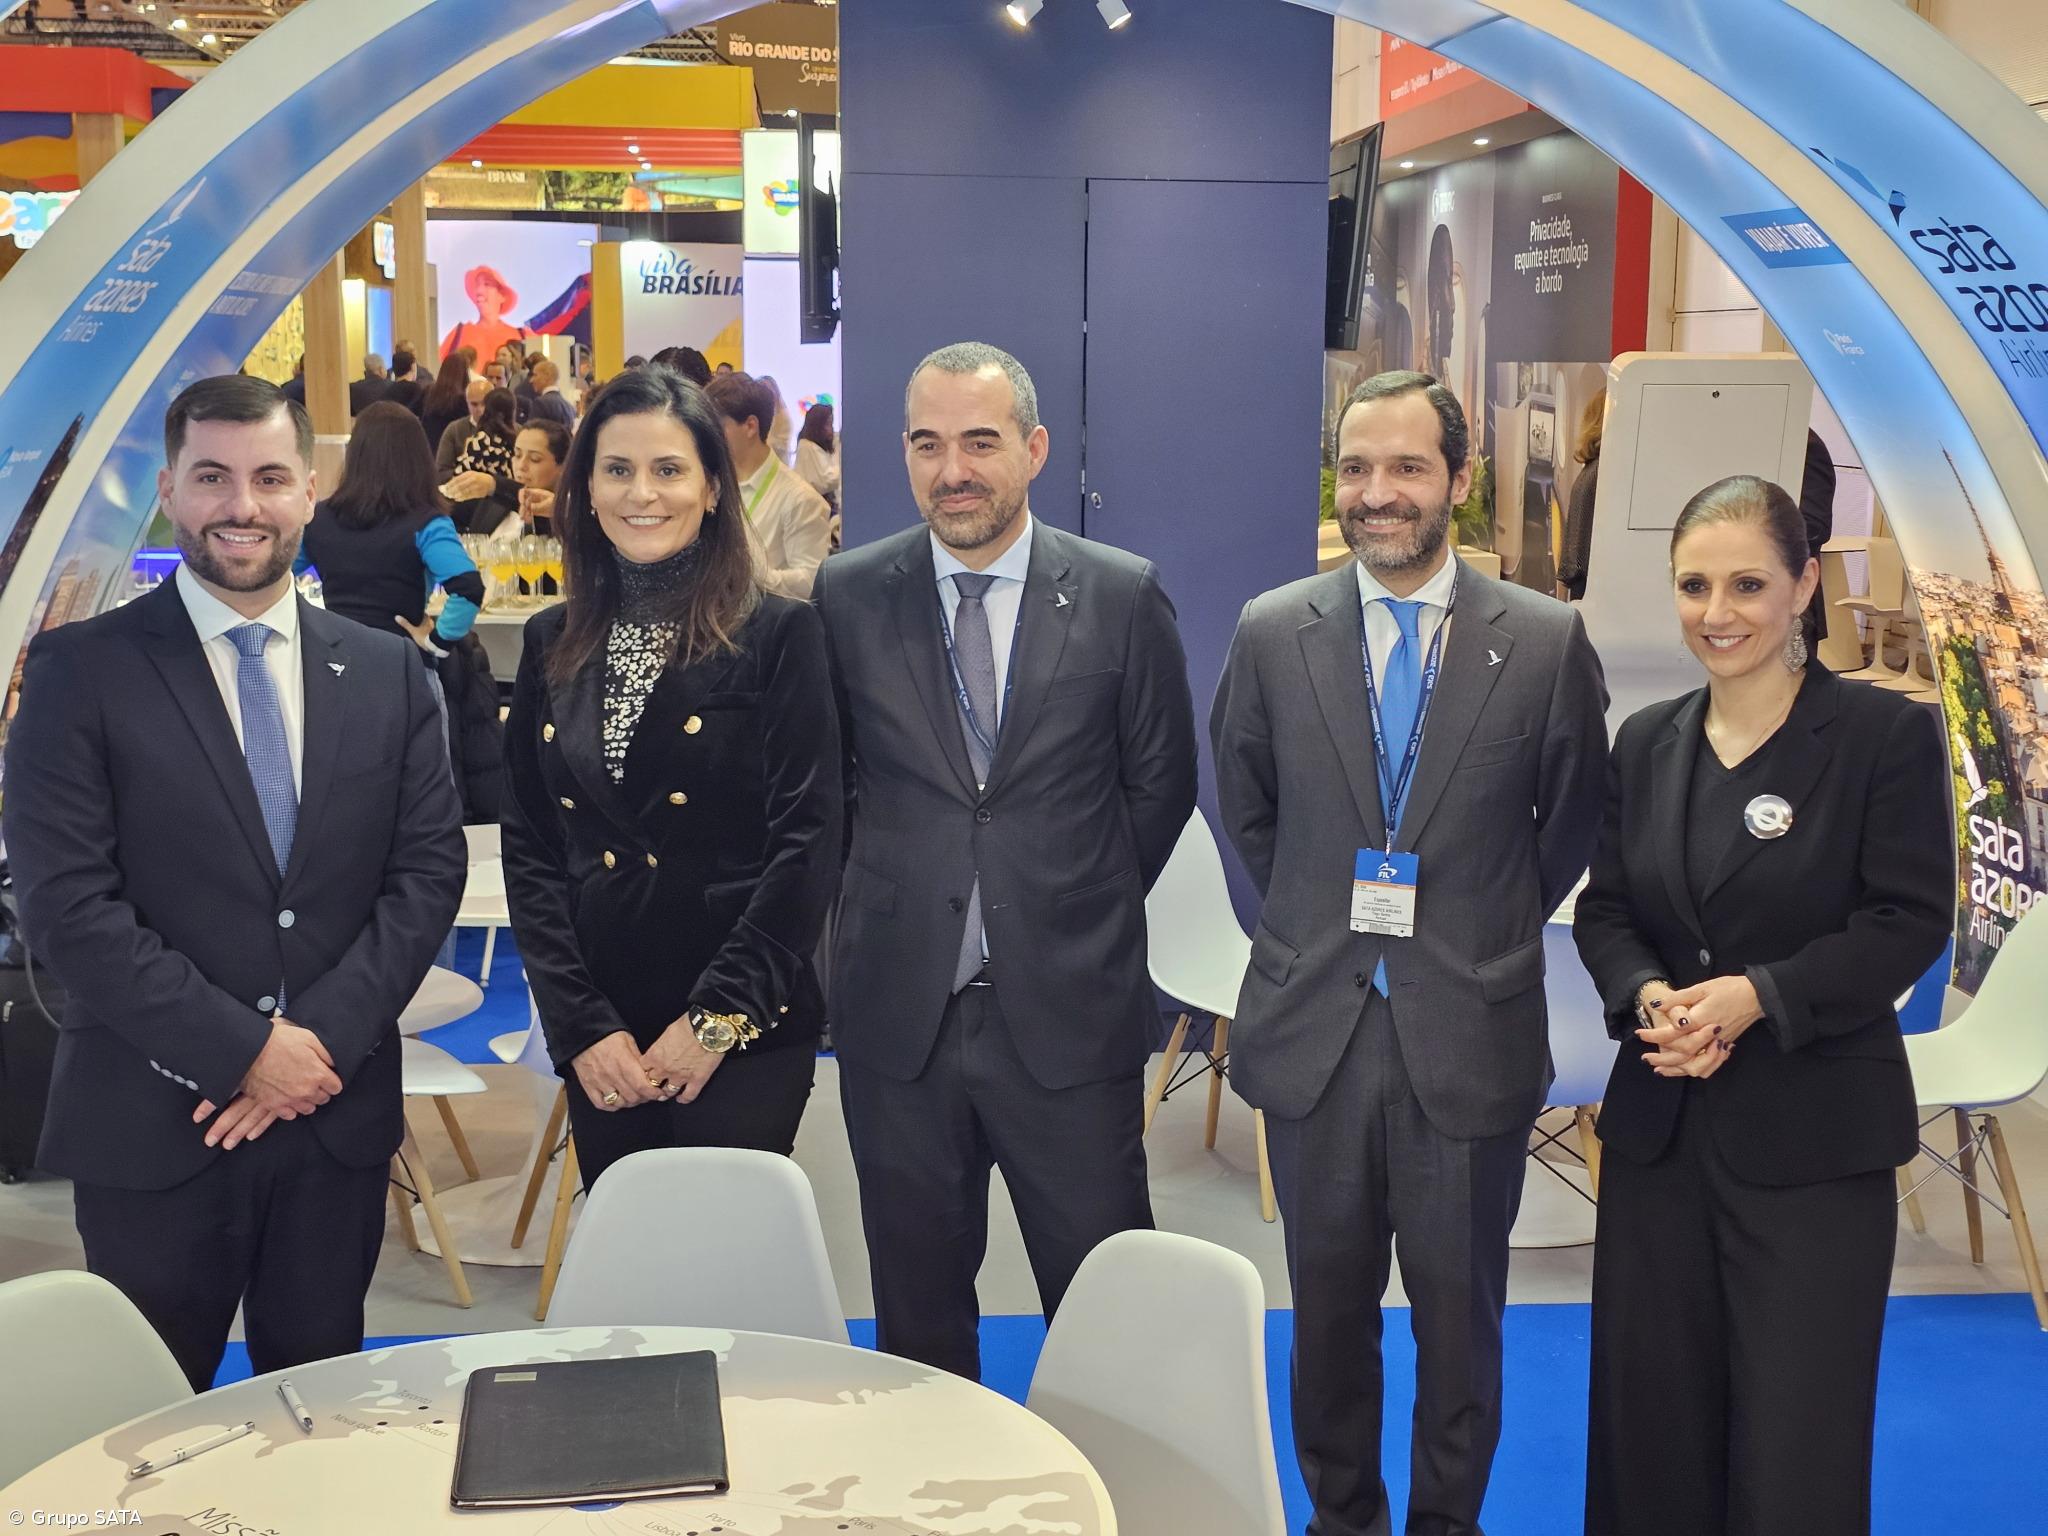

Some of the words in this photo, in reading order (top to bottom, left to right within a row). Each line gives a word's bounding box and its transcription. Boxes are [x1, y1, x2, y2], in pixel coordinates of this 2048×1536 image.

[729, 41, 753, 57] RIO
[755, 43, 810, 61] GRANDE
[811, 47, 832, 63] DO
[1530, 213, 1573, 242] Privacidade,
[1744, 227, 1793, 254] VIAJAR
[1772, 221, 1801, 250] É
[1782, 222, 1830, 249] VIVER
[117, 234, 172, 273] sata
[1514, 245, 1543, 275] requinte
[1543, 249, 1549, 266] e
[1549, 238, 1589, 269] tecnologia
[1909, 216, 2017, 275] sata
[642, 269, 743, 296] BRASÍLIA
[1535, 275, 1540, 293] a
[1541, 269, 1563, 293] bordo
[83, 278, 159, 313] azores
[1430, 643, 1439, 668] azores
[1426, 674, 1435, 689] sata
[1968, 814, 2025, 872] sata
[1377, 871, 1391, 879] FIL
[1969, 905, 2012, 950] Airlin
[414, 1422, 449, 1438] Boston
[705, 1512, 737, 1527] Porto
